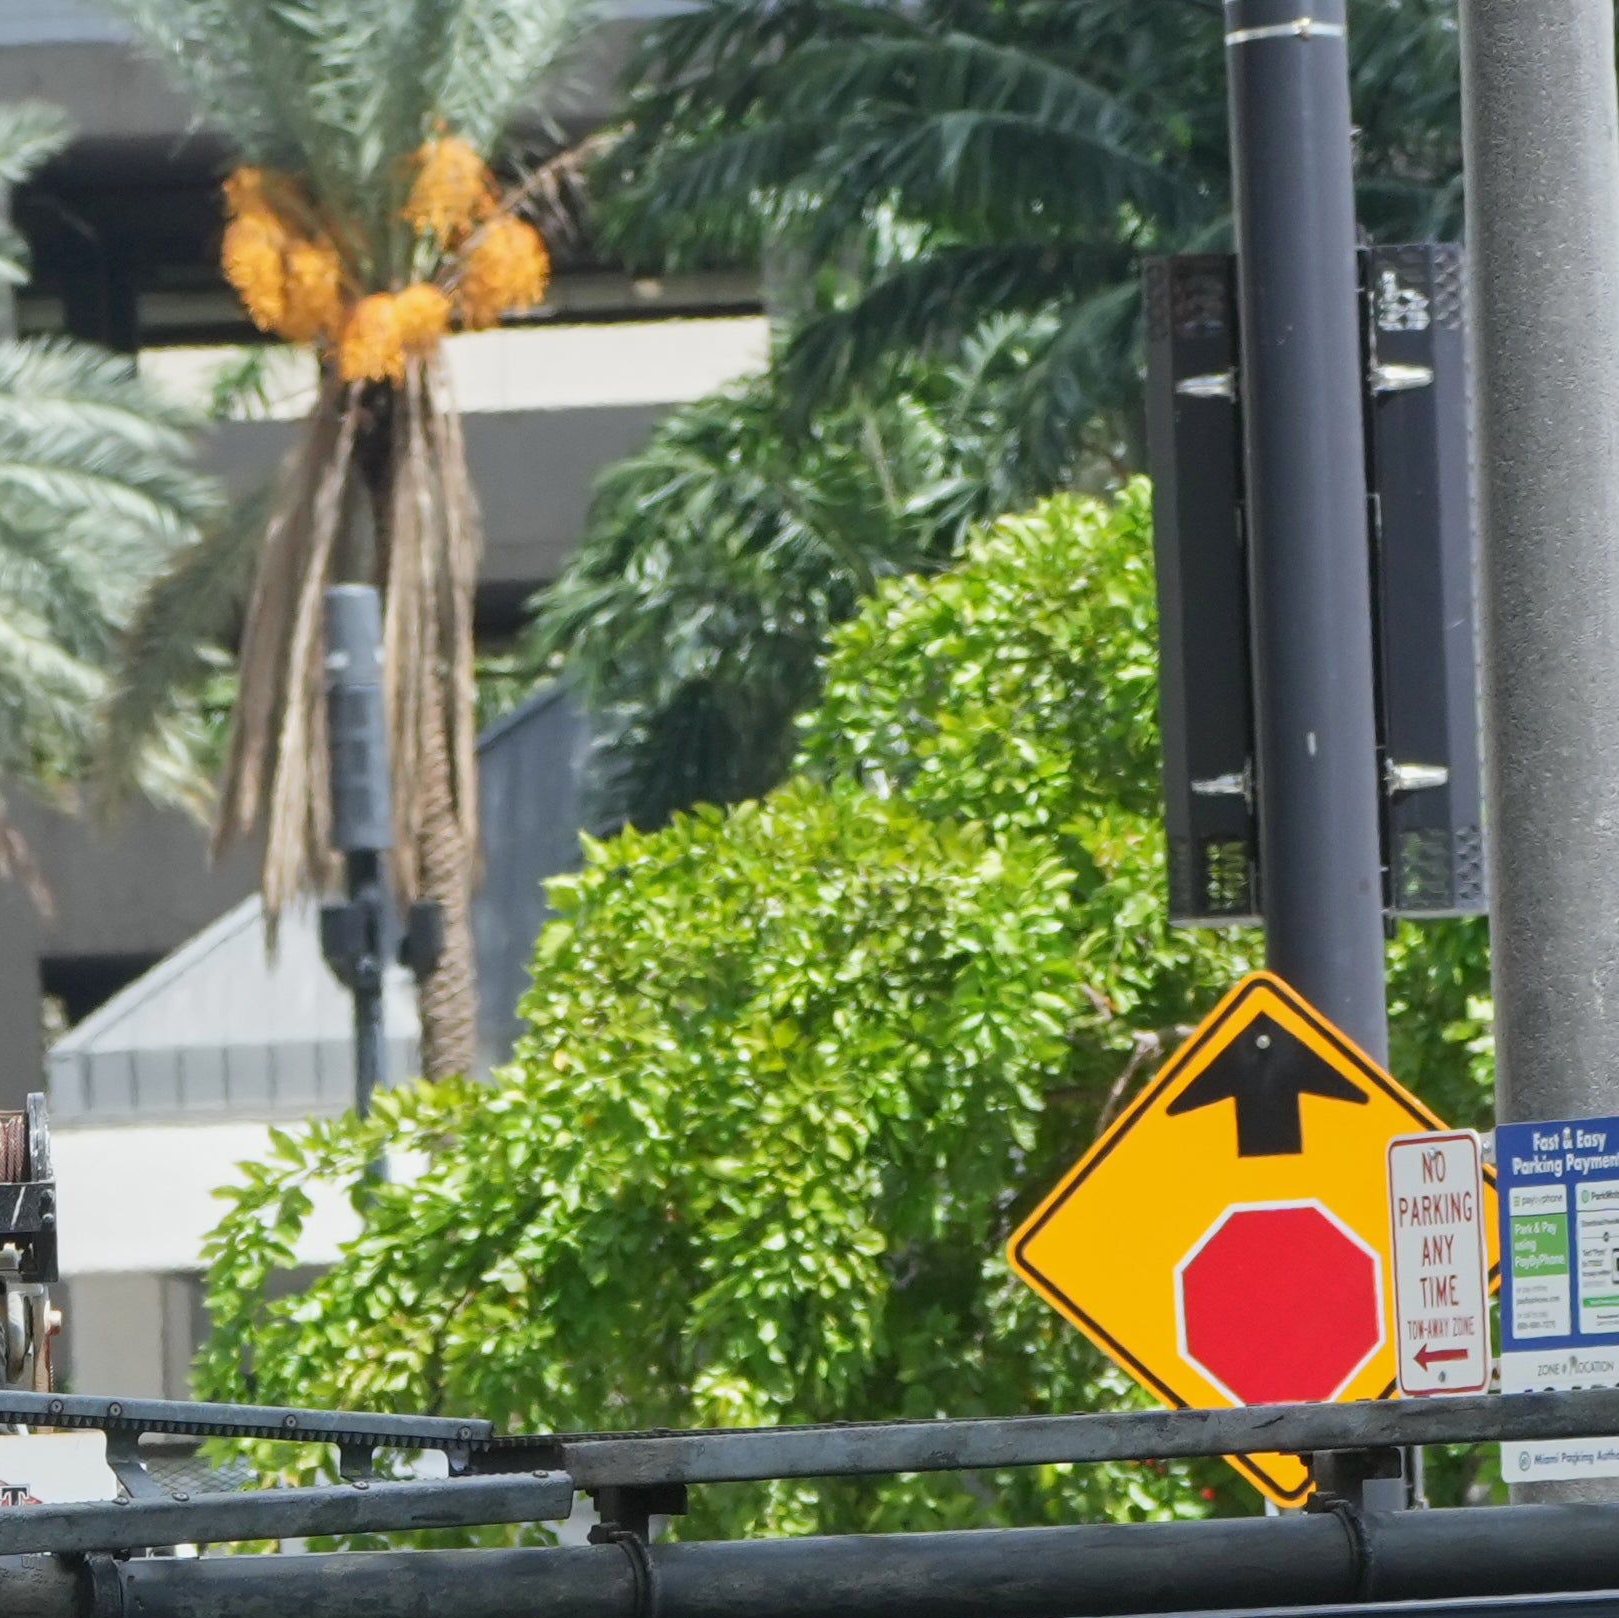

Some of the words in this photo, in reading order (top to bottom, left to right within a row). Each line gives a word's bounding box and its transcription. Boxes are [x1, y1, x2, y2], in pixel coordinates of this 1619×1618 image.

[1532, 1131, 1560, 1151] Fast
[1576, 1129, 1607, 1152] Easy
[1422, 1151, 1446, 1184] NO
[1512, 1154, 1563, 1177] Parking
[1399, 1191, 1473, 1228] PARKING
[1421, 1234, 1454, 1267] ANY
[1420, 1275, 1460, 1308] TIME
[1407, 1318, 1450, 1341] TOW-AWAY
[1453, 1316, 1475, 1337] ZONE
[1537, 1363, 1560, 1377] ZONE
